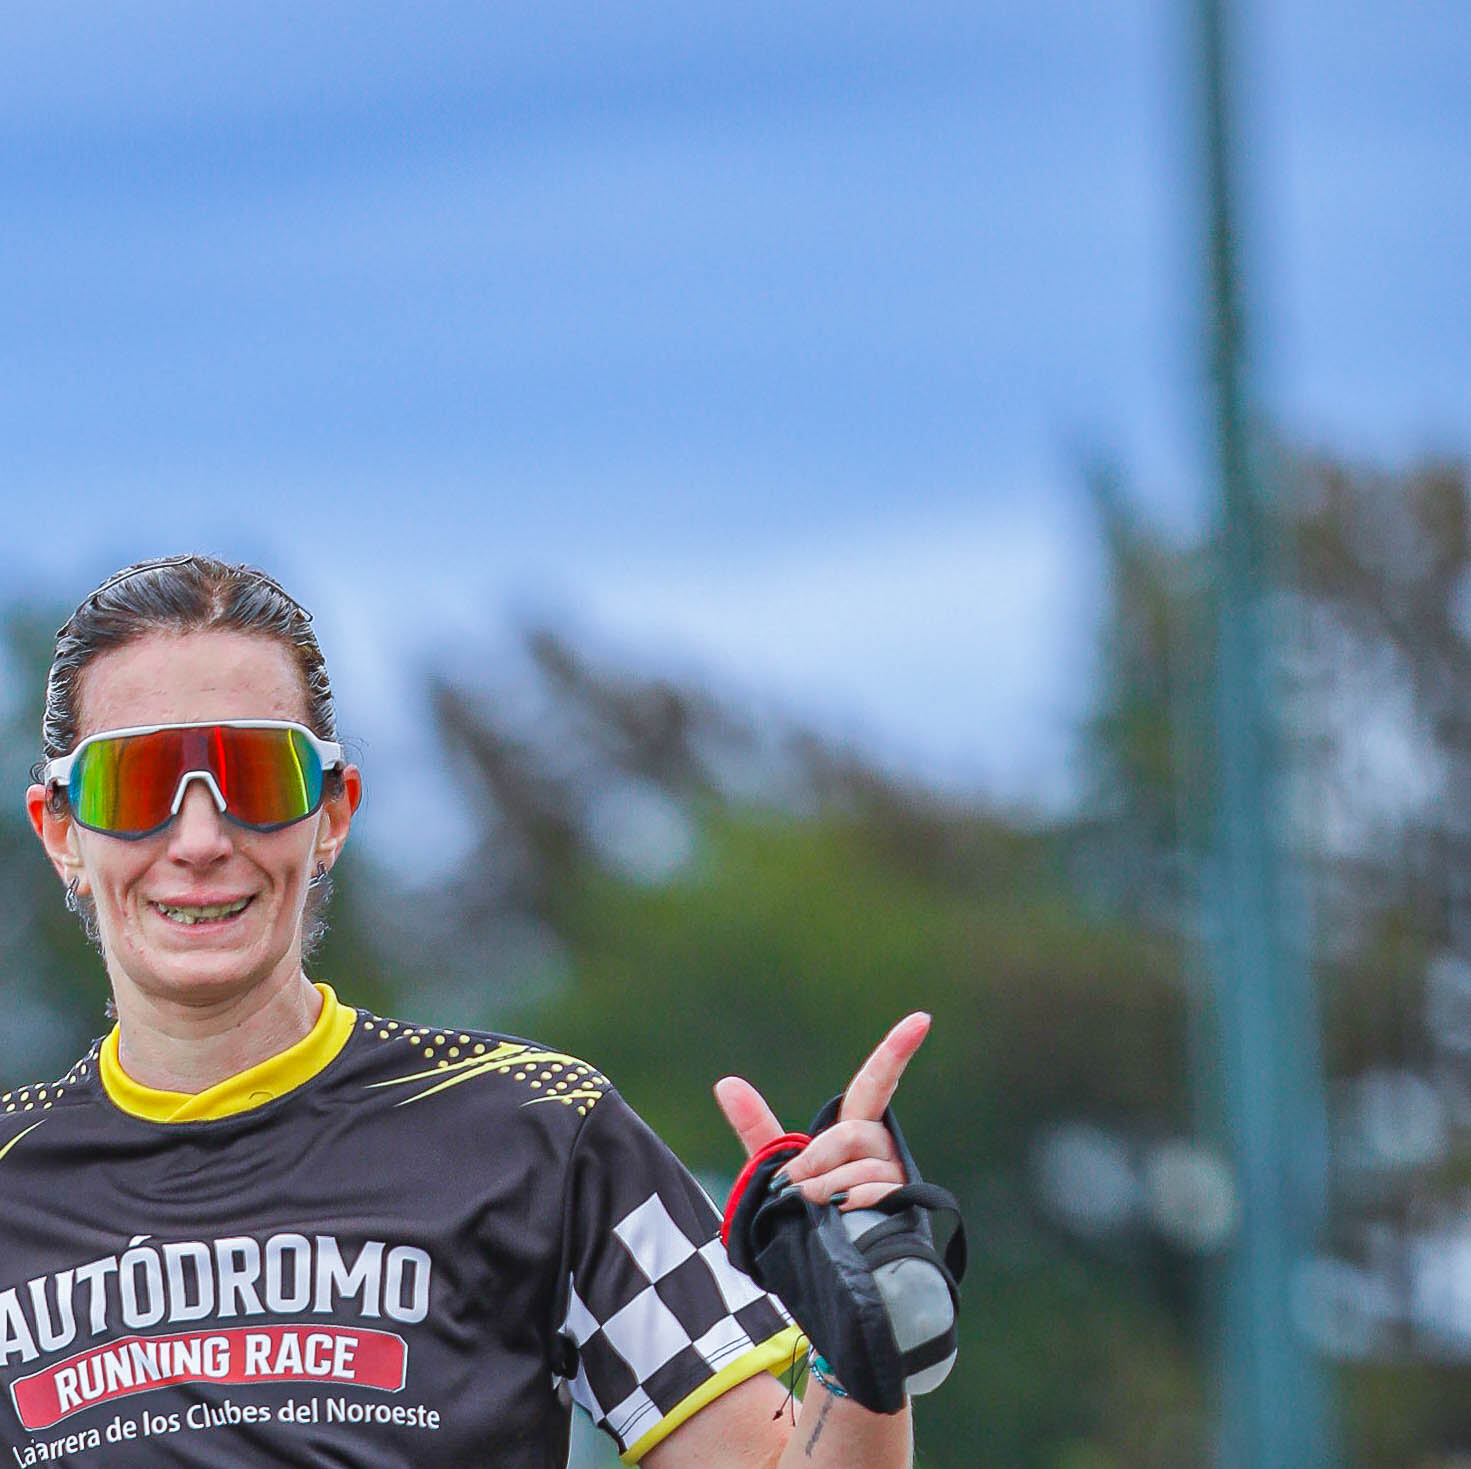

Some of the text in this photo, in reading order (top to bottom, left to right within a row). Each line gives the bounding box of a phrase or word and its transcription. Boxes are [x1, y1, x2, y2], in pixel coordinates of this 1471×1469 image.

[53, 1334, 359, 1413] RUNNING RACE
[31, 1428, 101, 1461] arrera
[106, 1416, 137, 1443] de
[142, 1411, 181, 1436] los
[187, 1401, 270, 1430] Clubes
[278, 1399, 318, 1423] del
[327, 1398, 440, 1429] Noroeste
